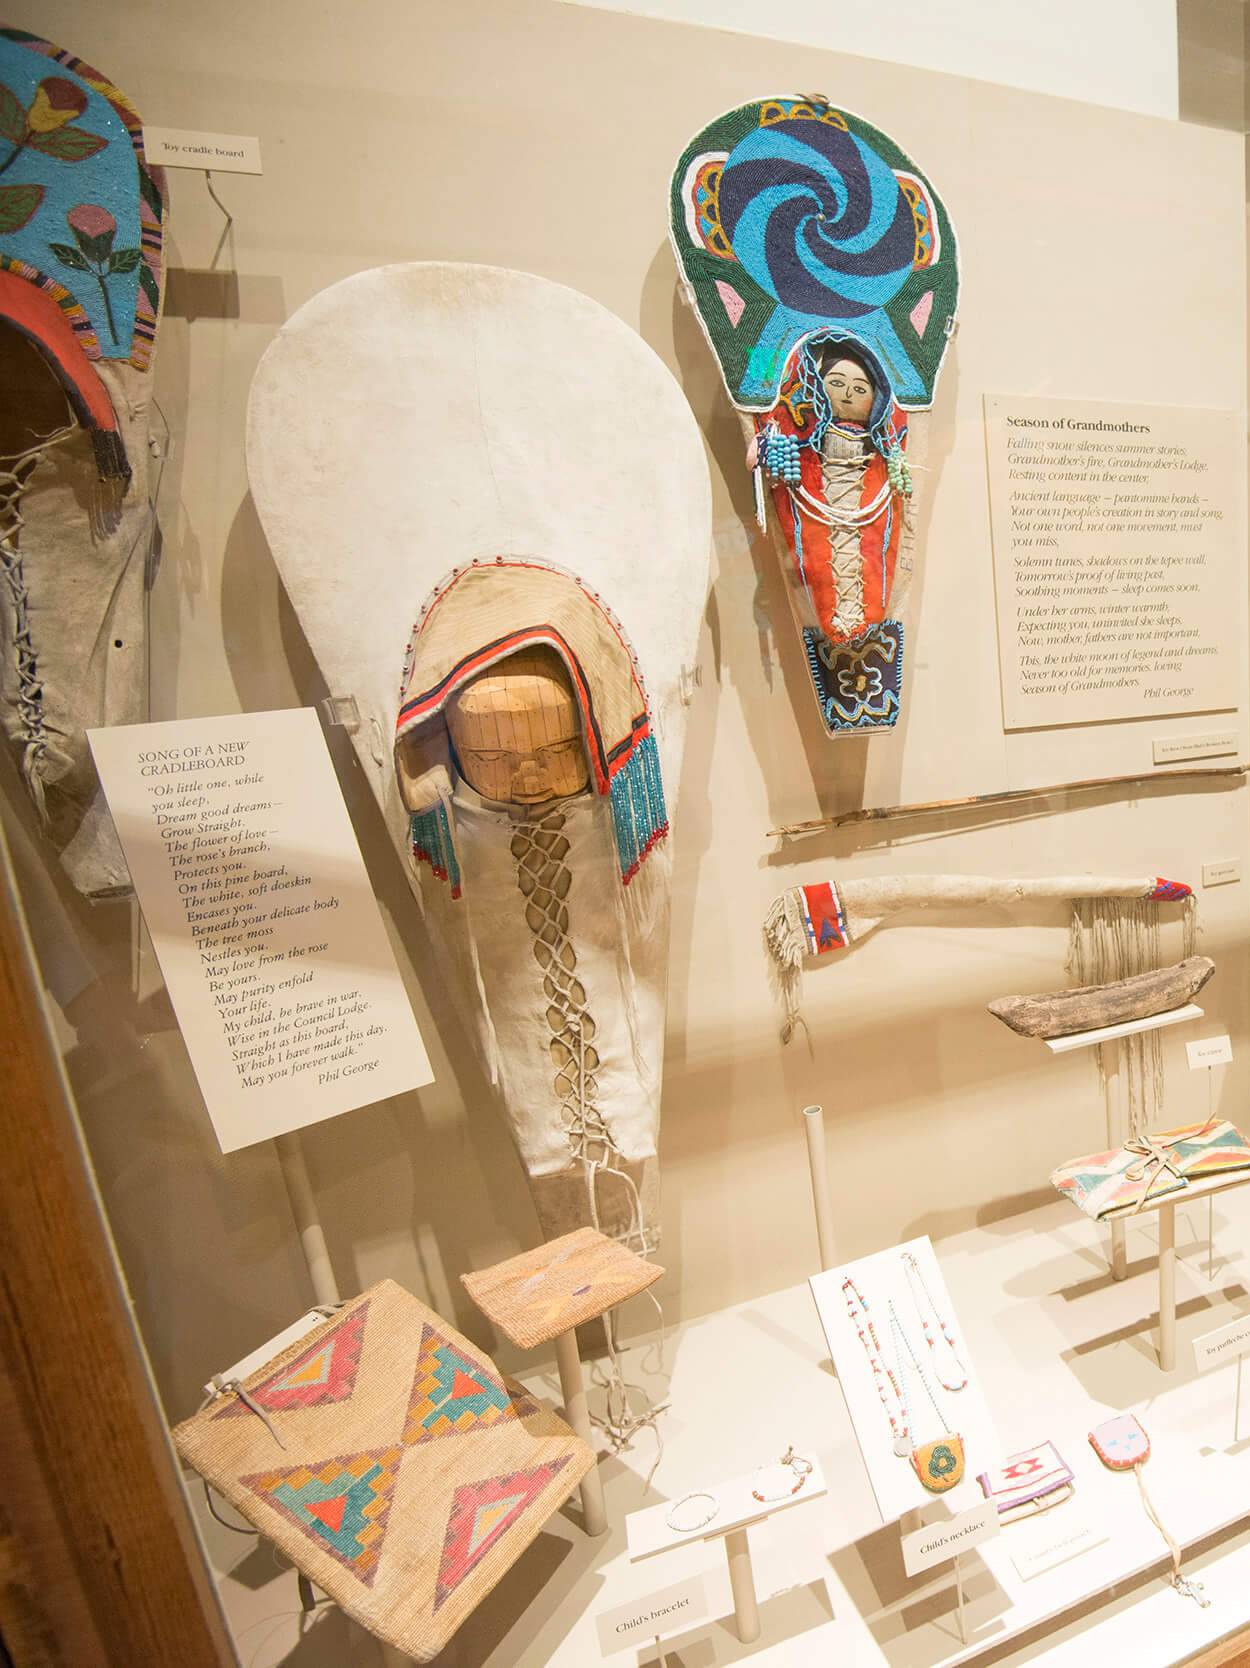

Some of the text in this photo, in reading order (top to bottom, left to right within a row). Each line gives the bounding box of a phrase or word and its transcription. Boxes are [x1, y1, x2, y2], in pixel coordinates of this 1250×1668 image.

[161, 142, 245, 157] Toy cradle board
[1006, 415, 1151, 434] Season of Grandmothers
[1006, 437, 1045, 453] Falling
[1045, 442, 1076, 452] snow
[1075, 440, 1115, 453] silences
[1114, 444, 1157, 455] summer
[1008, 468, 1047, 484] Resting
[1047, 471, 1088, 482] content
[1088, 470, 1101, 482] in
[1101, 470, 1118, 483] the
[1010, 538, 1034, 551] you
[1012, 555, 1053, 568] Solemn
[1085, 554, 1129, 567] shadows
[1128, 557, 1144, 566] on
[1144, 554, 1160, 566] the
[1160, 556, 1185, 569] tepee
[1073, 568, 1105, 585] proof
[1103, 568, 1117, 584] of
[1115, 568, 1144, 583] living
[1016, 604, 1051, 618] Under
[1050, 604, 1069, 617] her
[1099, 603, 1131, 615] winter
[1016, 619, 1068, 635] Expecting
[1091, 615, 1140, 629] uninvited
[1138, 615, 1156, 627] she
[1082, 631, 1117, 647] fathers
[1117, 632, 1135, 642] are
[1135, 631, 1154, 641] not
[1019, 669, 1051, 681] Never
[1050, 669, 1069, 679] too
[1069, 664, 1088, 678] old
[1085, 664, 1104, 680] for
[1153, 660, 1183, 673] loving
[1020, 683, 1057, 695] Season
[1057, 680, 1072, 695] of
[1143, 687, 1197, 699] Phil George
[137, 740, 250, 764] SONG OF A NEW
[140, 754, 246, 777] CRADLEBOARD
[176, 780, 204, 794] little
[234, 772, 265, 786] while
[151, 801, 174, 815] you
[156, 812, 198, 826] Dream
[200, 803, 230, 822] good
[160, 817, 246, 840] Grow Straight.
[164, 839, 189, 853] The
[191, 829, 231, 852] flower
[229, 829, 245, 845] of
[168, 853, 193, 868] The
[228, 840, 271, 857] branch,
[173, 861, 247, 881] Protects you.
[177, 883, 198, 895] On
[200, 877, 222, 892] this
[223, 873, 250, 890] pine
[181, 875, 312, 909] The white, soft doeskin
[186, 903, 257, 923] Encases you.
[191, 895, 340, 937] Beneath your delicate body
[194, 927, 274, 951] The tree moss
[200, 943, 269, 965] Nestles you.
[204, 943, 329, 979] May love from the rose
[208, 974, 261, 993] Be yours.
[213, 970, 314, 1007] May purity enfold
[217, 997, 272, 1020] Your life.
[223, 1020, 241, 1034] My
[279, 1007, 293, 1019] be
[295, 999, 324, 1015] brave
[326, 994, 338, 1006] in
[226, 1032, 256, 1048] Wise
[258, 1027, 270, 1040] in
[272, 1021, 291, 1035] the
[292, 1007, 335, 1029] Council
[231, 1039, 277, 1062] Straight
[278, 1038, 291, 1049] as
[292, 1029, 313, 1044] this
[235, 1053, 276, 1076] Which
[277, 1051, 283, 1064] I
[285, 1047, 311, 1061] have
[312, 1034, 343, 1053] made
[345, 1030, 365, 1044] this
[241, 1075, 265, 1089] May
[267, 1068, 288, 1084] you
[290, 1055, 329, 1077] forever
[317, 1059, 380, 1085] Phil George
[920, 1520, 985, 1554] Child's necklace
[616, 1598, 689, 1632] Child's bracelet
